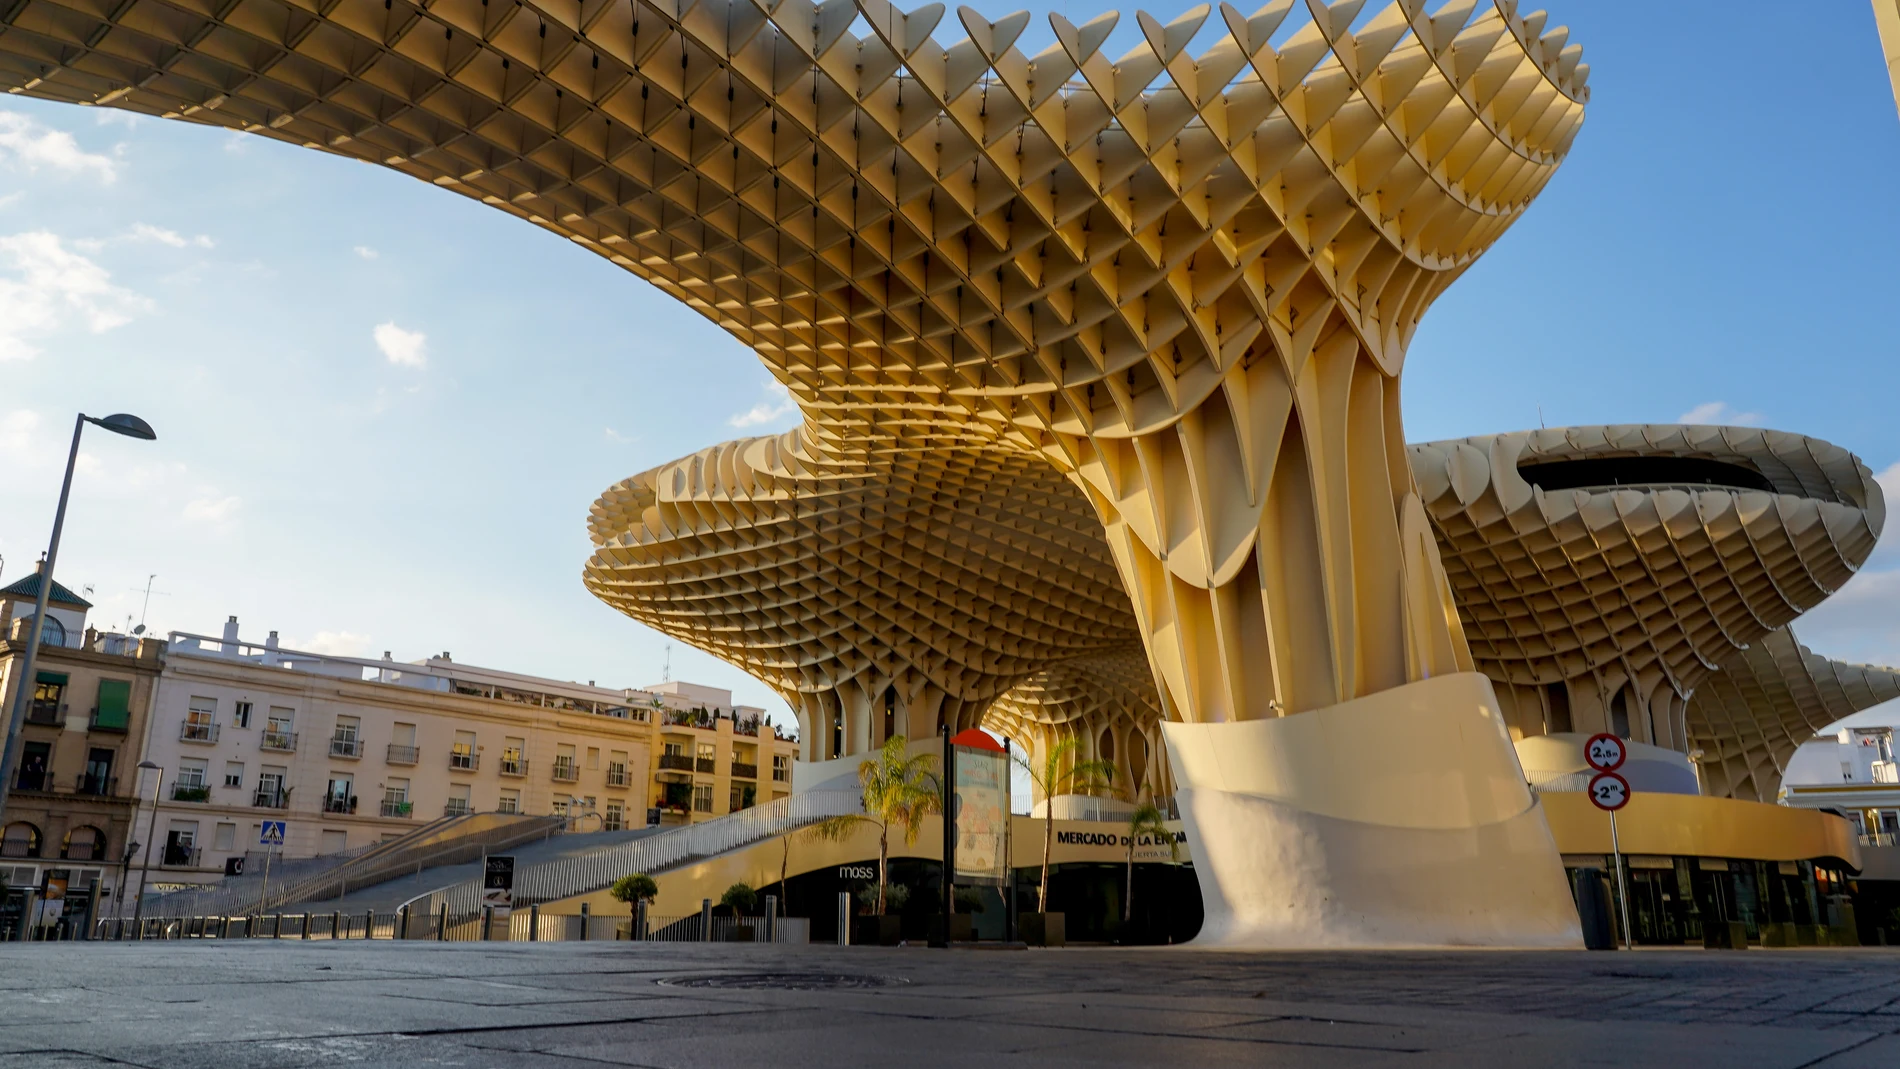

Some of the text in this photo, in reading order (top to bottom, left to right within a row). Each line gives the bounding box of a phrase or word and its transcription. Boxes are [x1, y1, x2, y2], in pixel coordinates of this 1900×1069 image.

[1057, 831, 1117, 846] MERCADO
[1138, 836, 1152, 846] LA
[839, 866, 874, 879] moss
